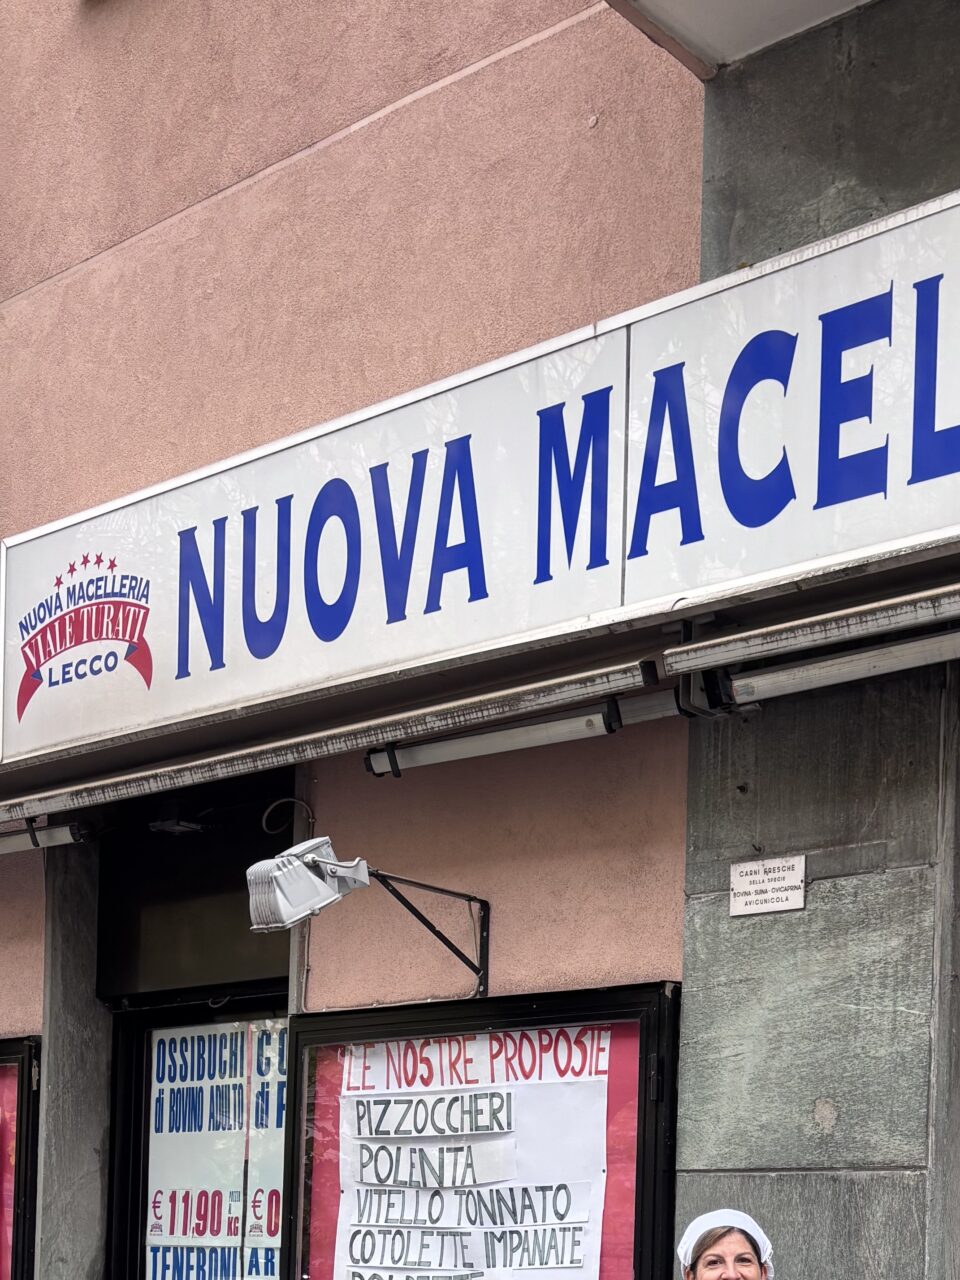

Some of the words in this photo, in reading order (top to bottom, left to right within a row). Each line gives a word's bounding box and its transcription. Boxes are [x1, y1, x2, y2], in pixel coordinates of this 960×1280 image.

[175, 434, 488, 679] NUOVA
[19, 591, 63, 641] NUOVA
[67, 575, 150, 609] MACELLERIA
[23, 613, 75, 669] VIALE
[80, 604, 146, 642] TURATI
[48, 651, 118, 687] LECCO
[739, 868, 760, 877] CARNI
[763, 864, 795, 876] FRESCHE
[771, 885, 801, 893] OVICAPRINA
[744, 896, 789, 906] AVICUNICOLA
[156, 1031, 245, 1084] OSSIBUCHI
[346, 1042, 376, 1091] LE
[386, 1034, 480, 1088] NOSTRE
[489, 1026, 609, 1084] PROPOSTE
[154, 1088, 165, 1133] di
[168, 1086, 204, 1133] BOVINO
[208, 1083, 243, 1132] ADULTO
[255, 1081, 269, 1129] di
[355, 1092, 512, 1135] PIZZOCCHERI
[360, 1145, 476, 1187] POLENTA
[152, 1190, 163, 1220] €
[168, 1190, 223, 1238] 11,90
[227, 1216, 239, 1236] KG
[251, 1189, 264, 1220] €
[356, 1189, 444, 1225] VITELLO
[454, 1183, 571, 1226] TONNATO
[349, 1230, 474, 1267] COTOLETTE
[484, 1227, 582, 1267] IMPANATE
